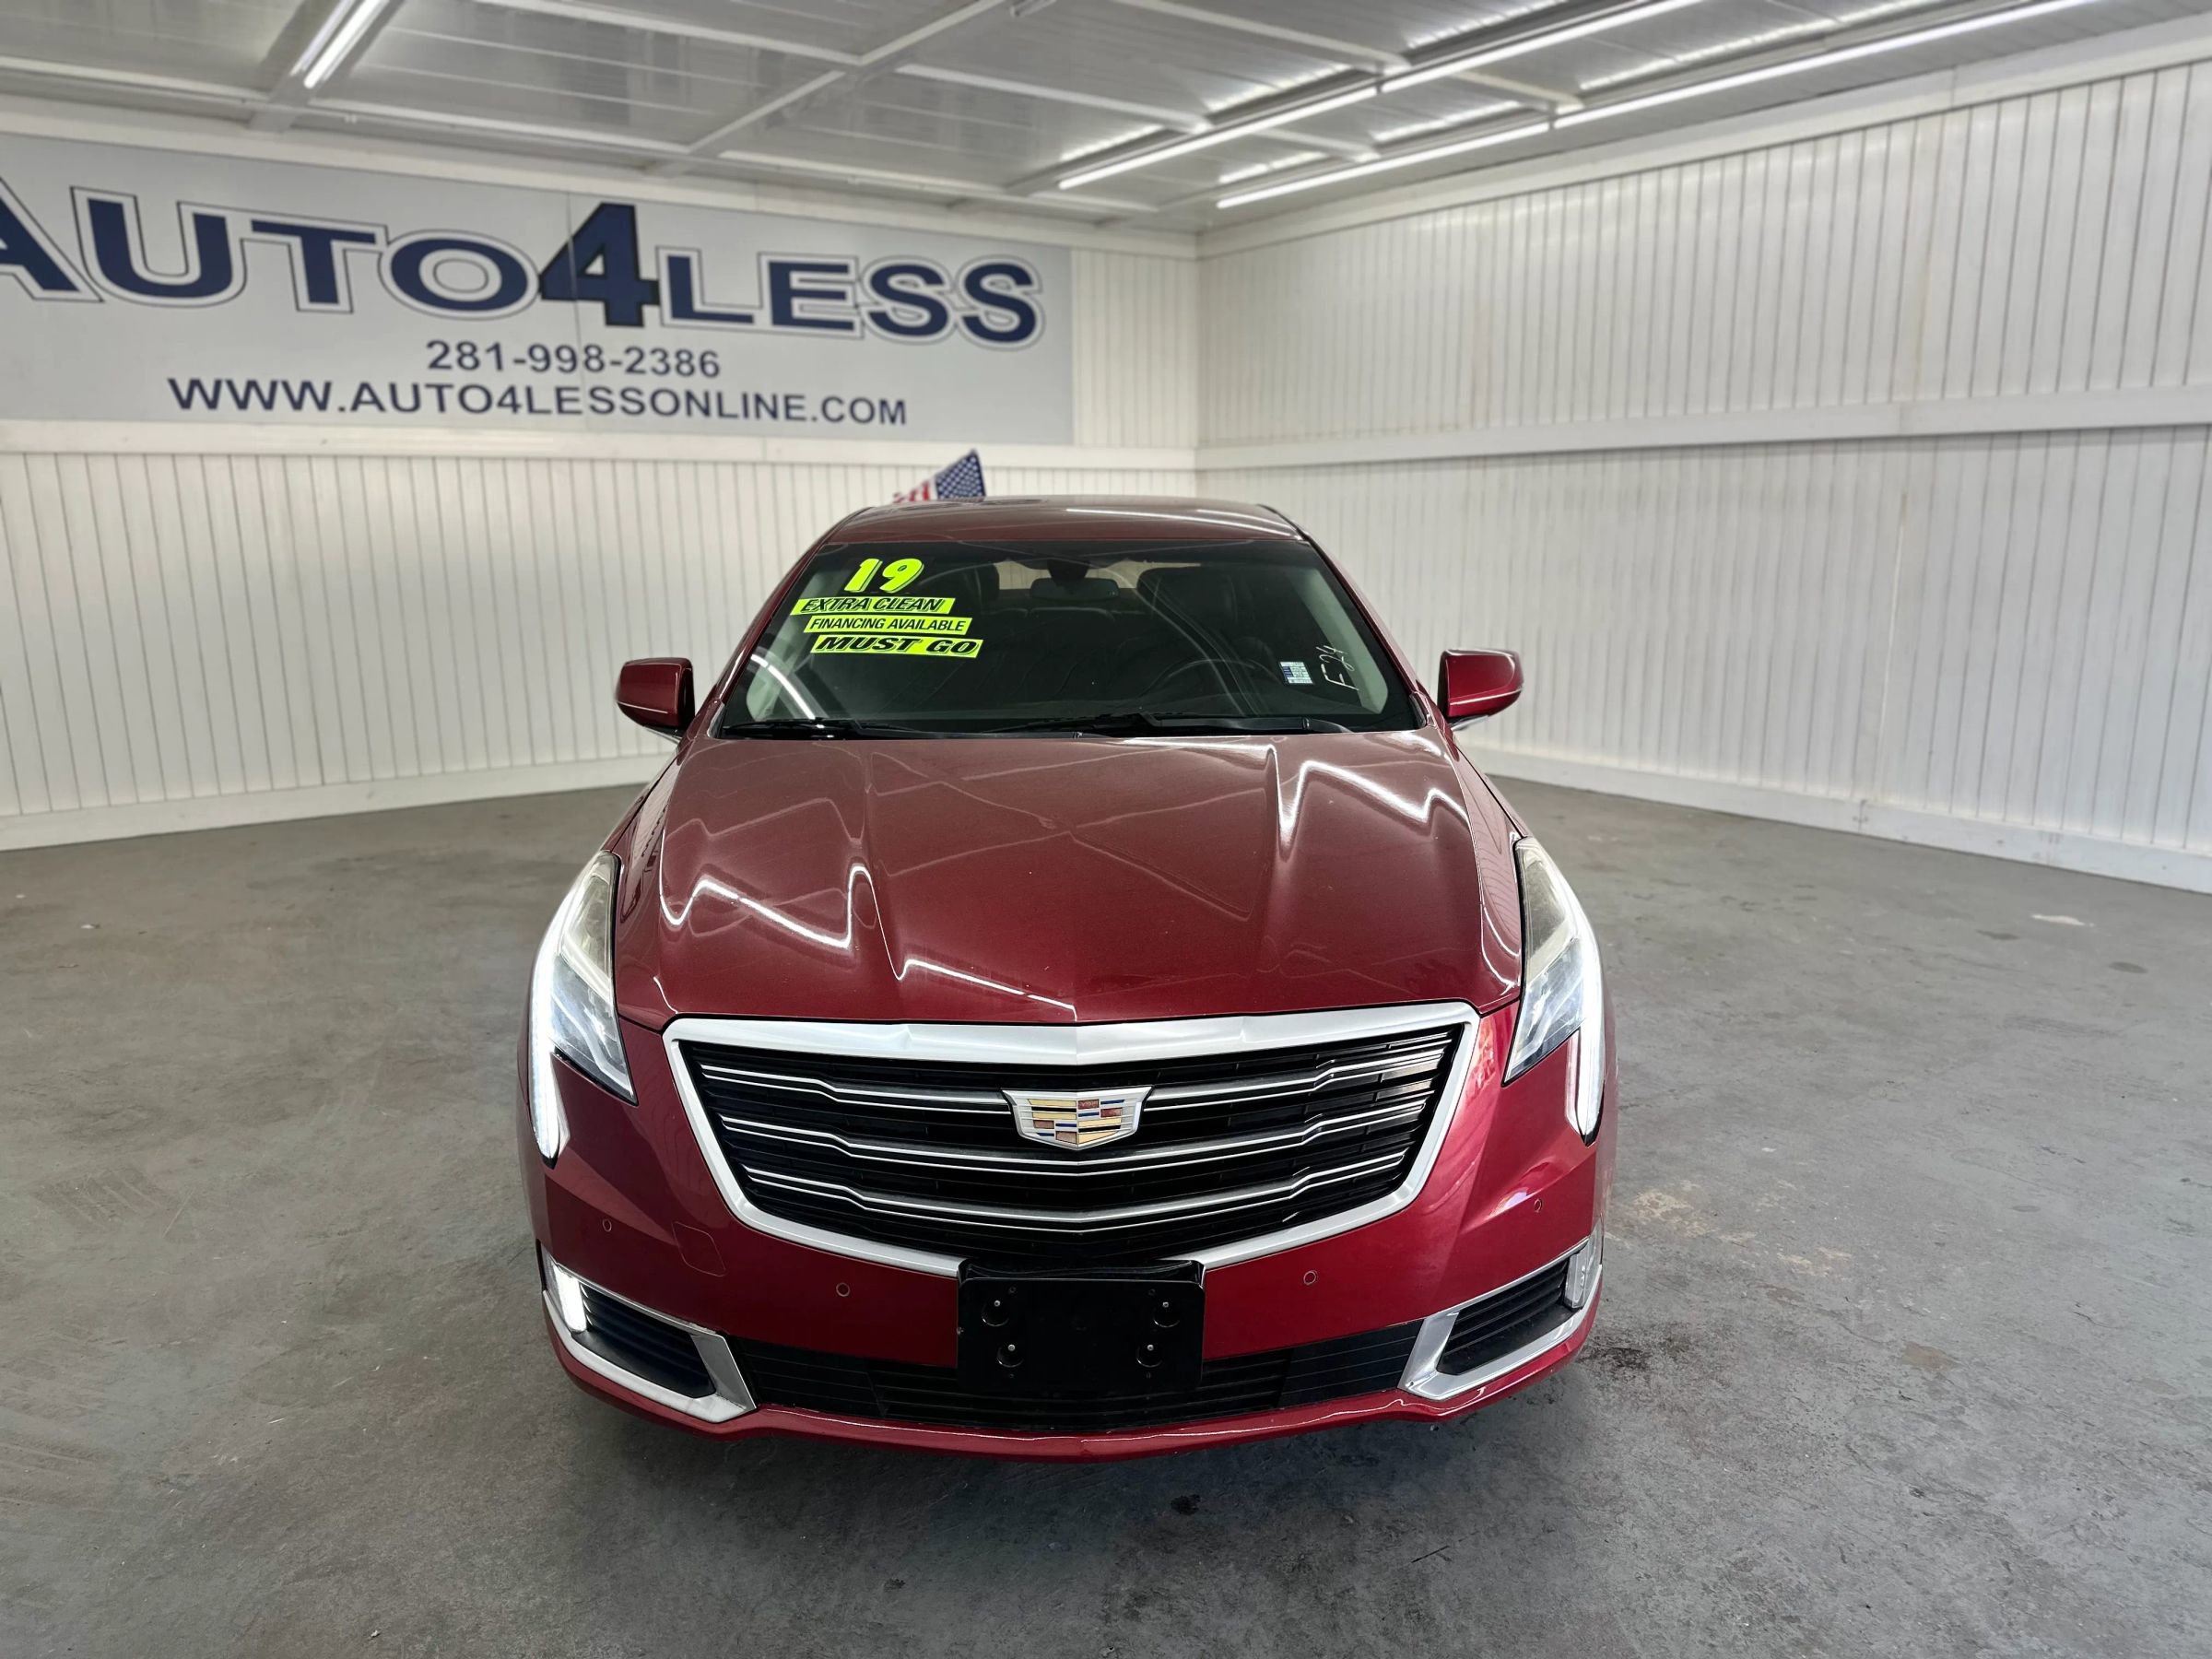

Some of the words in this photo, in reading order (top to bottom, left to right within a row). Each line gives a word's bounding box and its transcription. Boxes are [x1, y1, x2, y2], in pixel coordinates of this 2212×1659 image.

[426, 339, 721, 379] 281-998-2386
[167, 377, 908, 426] WWW.AUTO4LESSONLINE.COM
[844, 558, 924, 593] 19
[800, 597, 870, 613] EXTRA
[872, 598, 946, 612] CLEAN
[809, 618, 886, 630] FINANCING
[887, 618, 966, 631] AVAILABLE
[815, 636, 924, 653] MUST
[924, 639, 979, 654] GO
